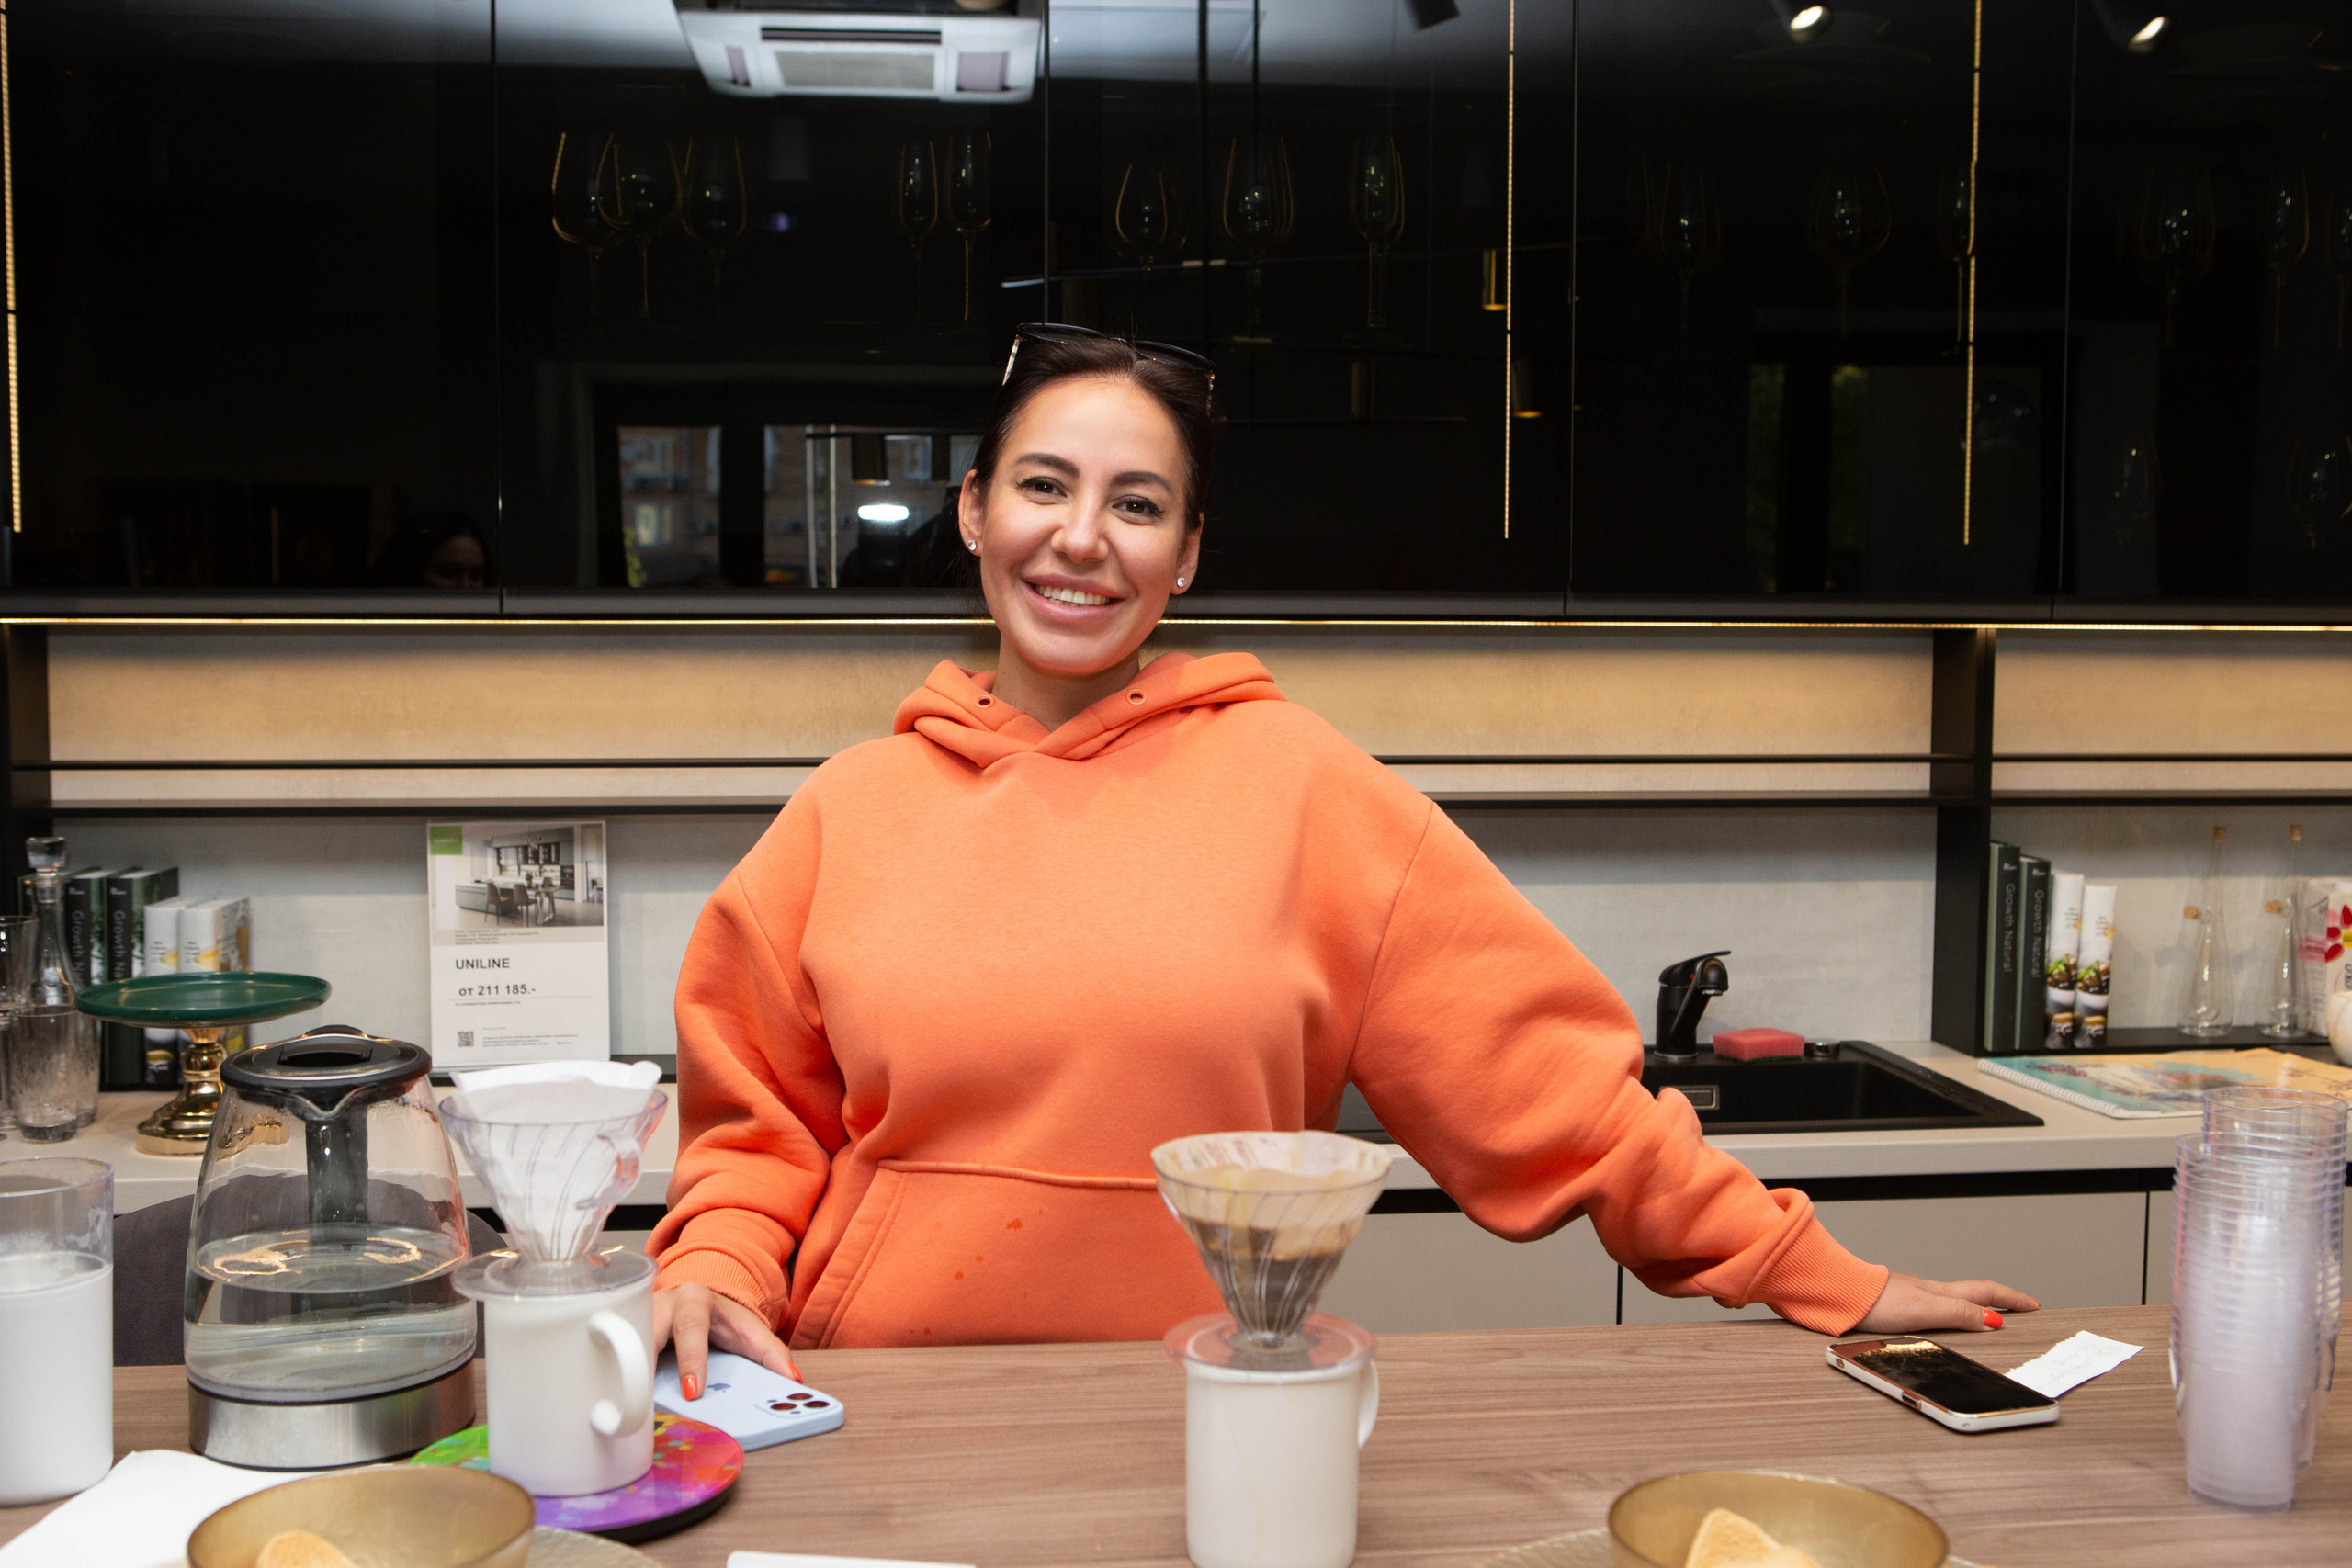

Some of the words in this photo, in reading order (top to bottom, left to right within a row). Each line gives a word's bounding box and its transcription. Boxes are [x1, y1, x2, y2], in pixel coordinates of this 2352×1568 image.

[2005, 883, 2016, 928] Growth
[2034, 889, 2045, 934] Growth
[71, 910, 85, 958] Growth
[113, 910, 127, 958] Growth
[2003, 930, 2014, 972] Natural
[456, 958, 510, 970] UNILINE
[2031, 937, 2042, 978] Natural
[458, 988, 473, 997] от
[478, 985, 499, 995] 211
